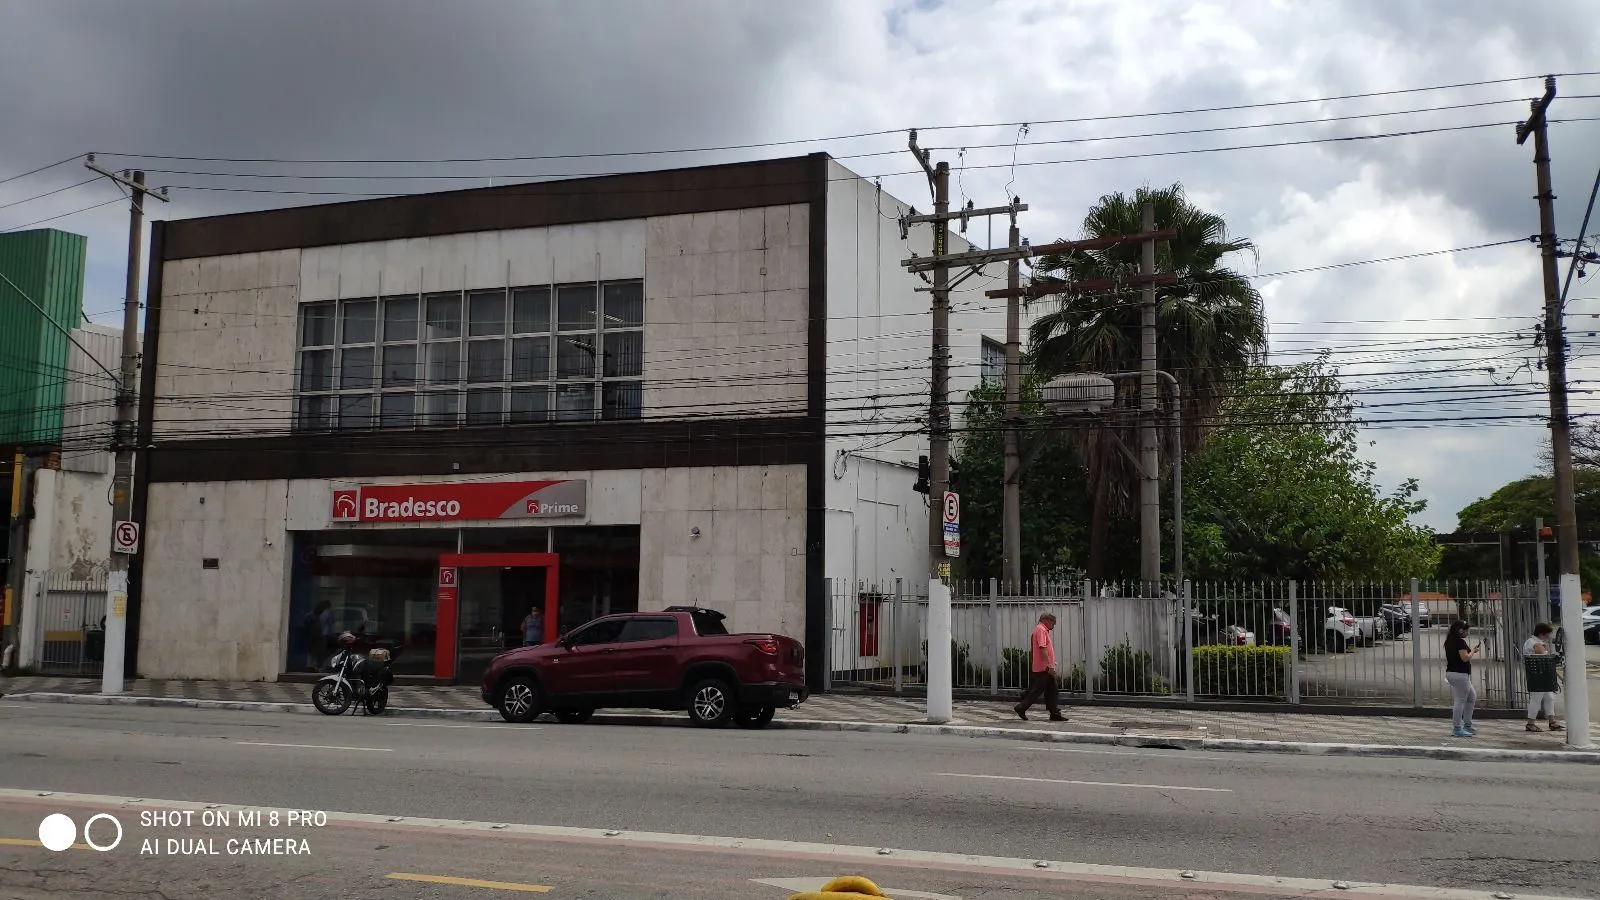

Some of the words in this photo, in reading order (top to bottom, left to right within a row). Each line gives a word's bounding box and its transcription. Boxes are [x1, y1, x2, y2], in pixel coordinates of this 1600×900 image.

[365, 497, 460, 518] Bradesco
[540, 502, 579, 514] Prime
[948, 500, 954, 516] E
